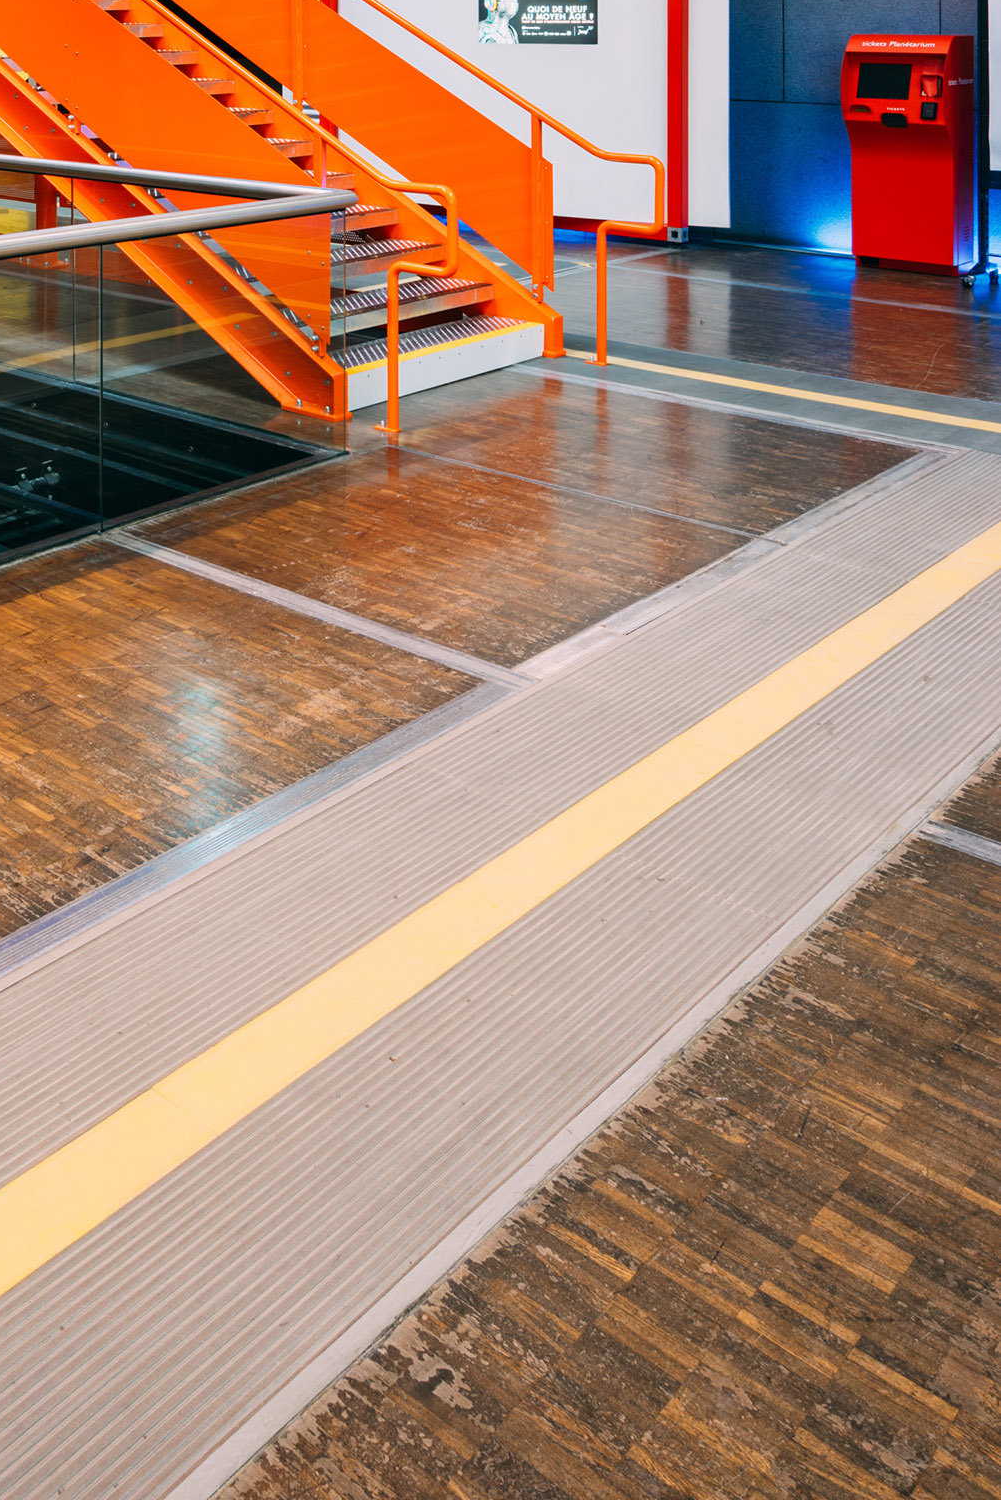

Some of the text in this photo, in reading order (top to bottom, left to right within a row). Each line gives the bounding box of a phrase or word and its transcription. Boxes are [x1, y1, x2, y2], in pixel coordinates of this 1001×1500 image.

[527, 5, 588, 13] QUOI DE NEUF
[862, 40, 936, 49] tickets Planétarium
